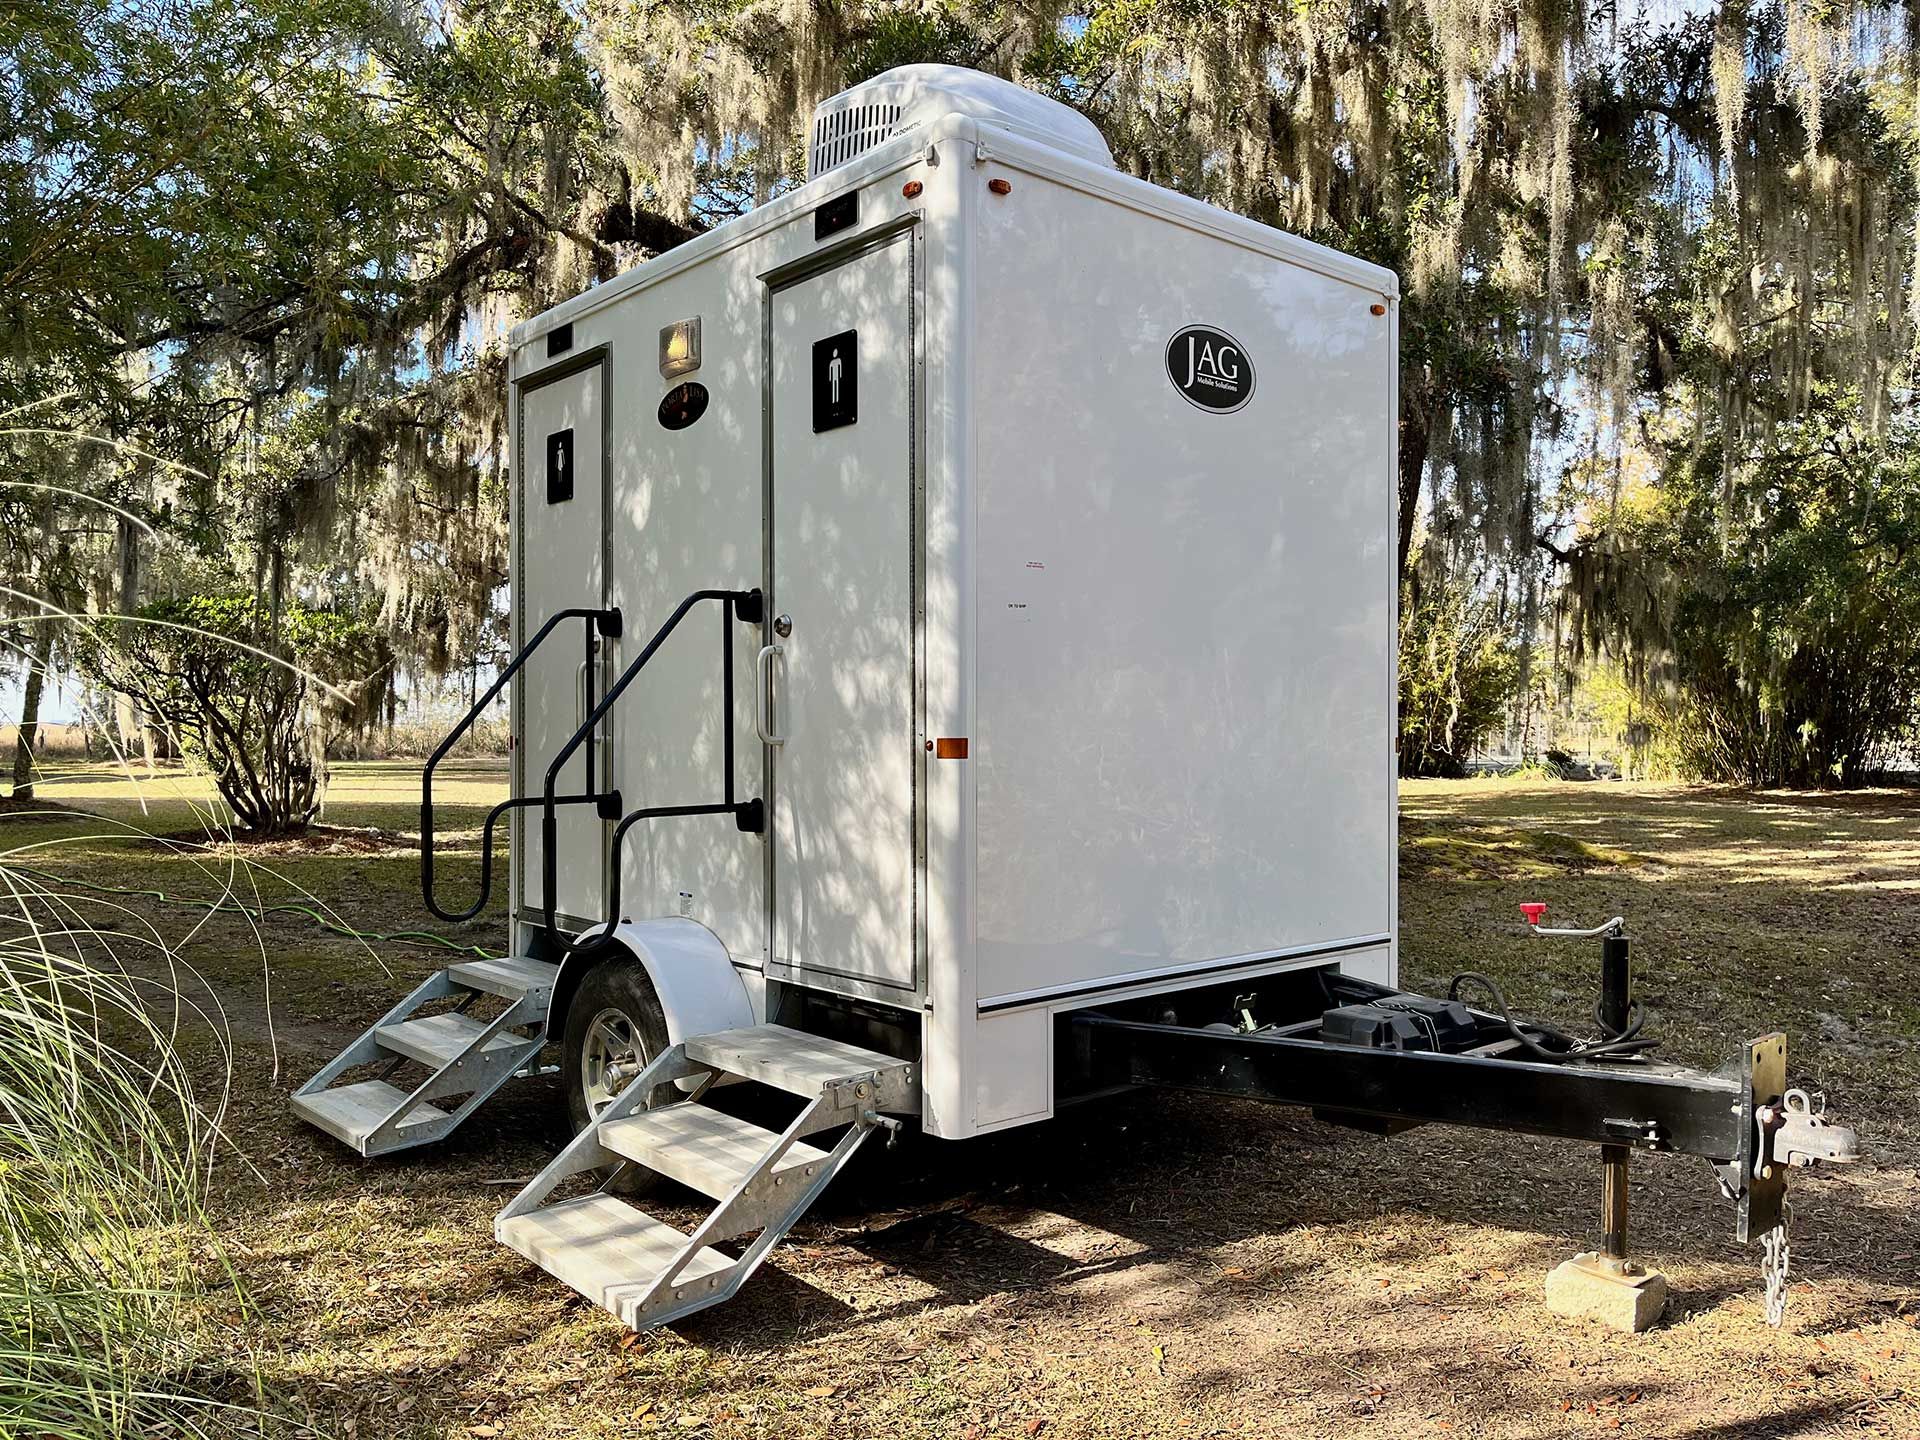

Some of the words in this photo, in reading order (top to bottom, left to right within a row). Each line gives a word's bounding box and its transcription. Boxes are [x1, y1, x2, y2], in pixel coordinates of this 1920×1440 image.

[1184, 335, 1238, 389] JAG
[1197, 376, 1215, 387] Mobile
[1215, 380, 1238, 393] Solutions
